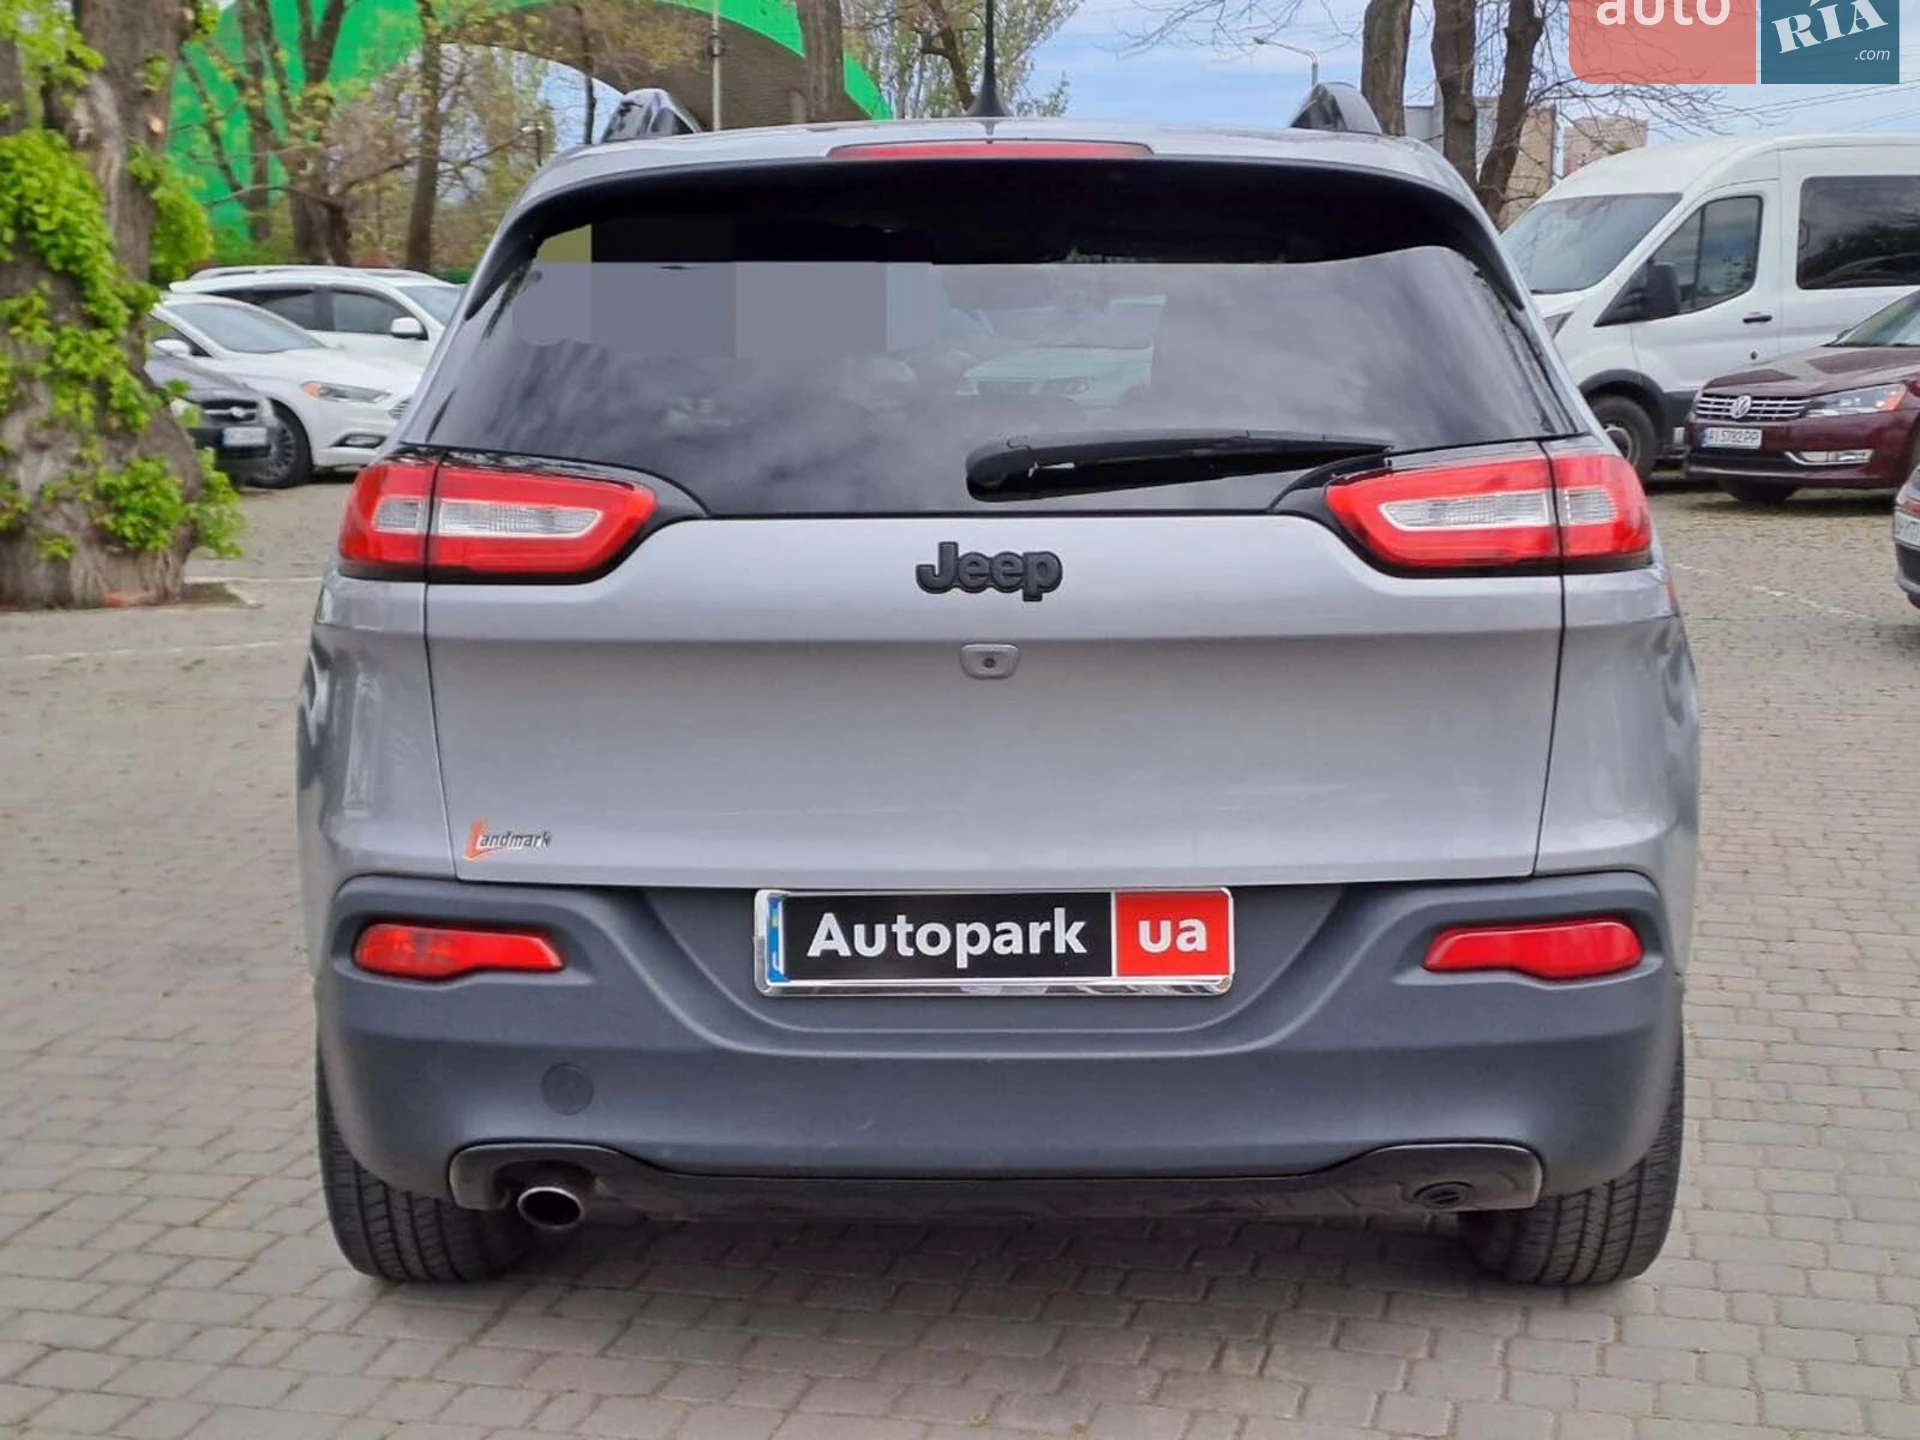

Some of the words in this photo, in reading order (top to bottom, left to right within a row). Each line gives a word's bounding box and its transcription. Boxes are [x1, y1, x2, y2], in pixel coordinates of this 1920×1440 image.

[916, 541, 1063, 602] Jeep
[465, 818, 552, 859] Landmark
[806, 907, 1088, 969] Autopark
[1138, 917, 1208, 954] ua
